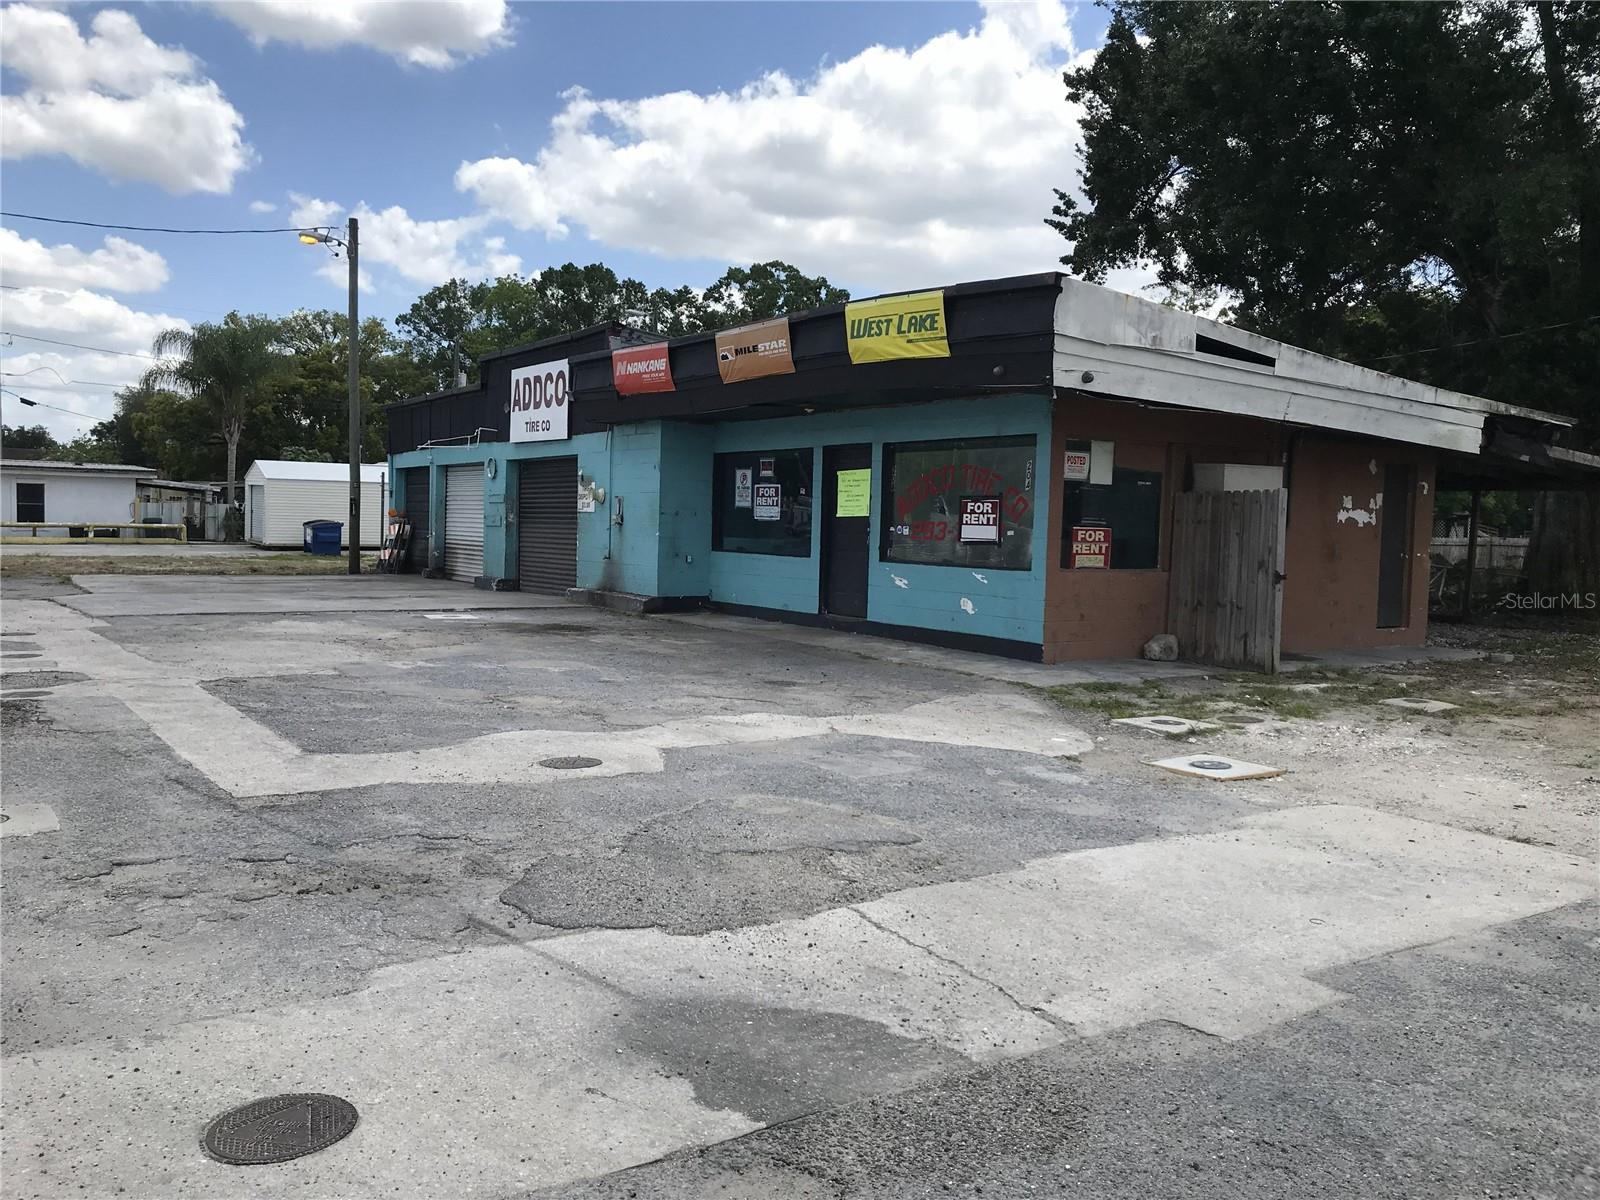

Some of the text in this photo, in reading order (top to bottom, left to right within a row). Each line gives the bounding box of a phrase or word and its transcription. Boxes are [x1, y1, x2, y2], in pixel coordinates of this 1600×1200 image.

[850, 313, 940, 339] WEST LAKE
[735, 340, 786, 356] MILESTAR
[627, 358, 667, 375] NANKANG
[512, 370, 567, 412] ADDCO
[525, 418, 551, 432] TIRE CO
[1067, 455, 1086, 465] POSTED
[760, 488, 776, 496] FOR
[756, 497, 778, 506] RENT
[967, 502, 992, 513] FOR
[962, 514, 996, 525] RENT
[1077, 530, 1105, 542] FOR
[1072, 543, 1109, 554] RENT
